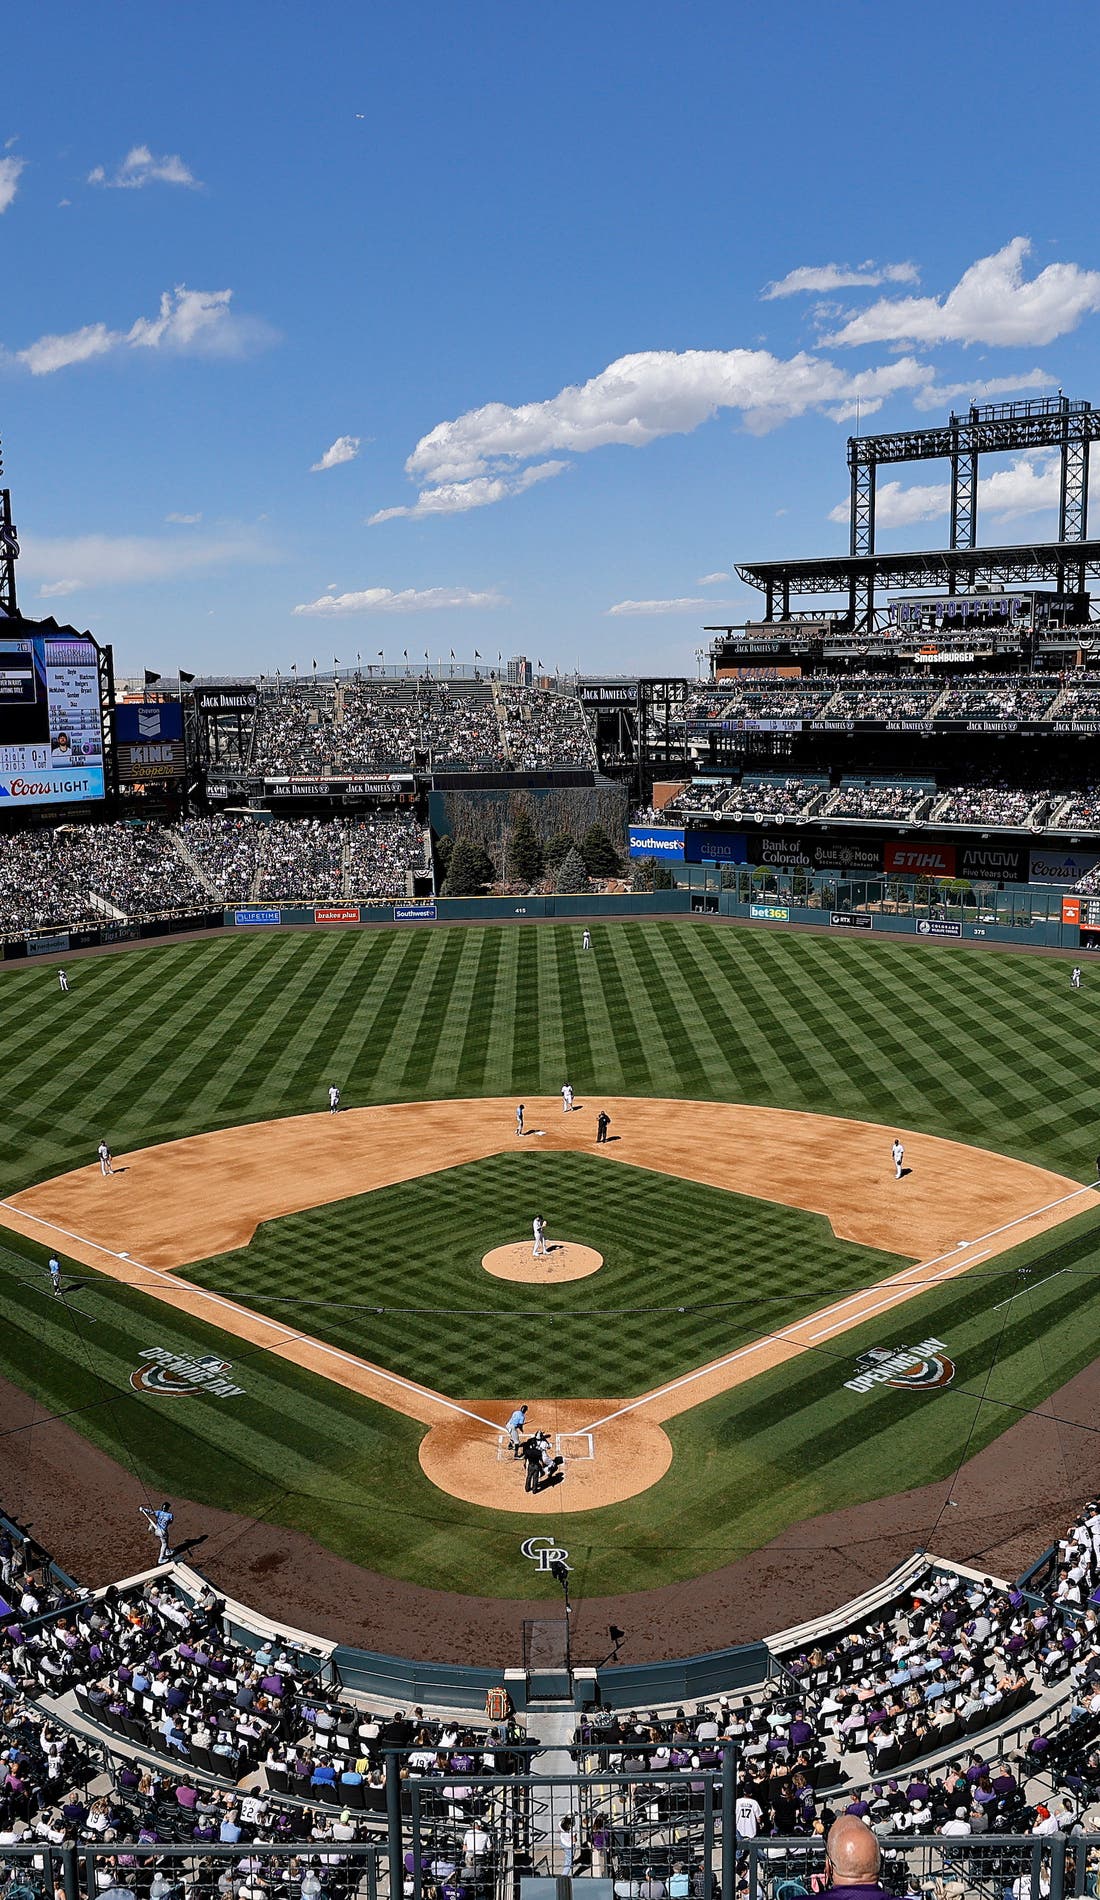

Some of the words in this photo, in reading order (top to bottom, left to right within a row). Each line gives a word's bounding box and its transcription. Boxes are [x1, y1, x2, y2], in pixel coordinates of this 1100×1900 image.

[890, 602, 922, 620] THE
[936, 598, 1022, 618] ROOFTOP
[734, 644, 748, 653] JACK
[581, 688, 599, 700] JACK
[600, 687, 627, 700] DANIEL'S
[200, 694, 219, 707] JACK
[220, 694, 248, 706] DANIEL'S
[810, 721, 824, 729] JACK
[824, 721, 846, 729] DANIEL'S
[886, 721, 900, 730] JACK
[902, 721, 924, 730] DANIEL'S
[967, 721, 982, 730] JACK
[984, 721, 1007, 731] DANIEL'S
[1053, 722, 1069, 731] JACK
[1072, 722, 1096, 732] DANIEL'S
[130, 745, 173, 763] KING
[131, 763, 174, 778] Soopers
[10, 779, 51, 796] Coors
[53, 780, 88, 793] LIGHT
[273, 785, 290, 794] JACK
[292, 784, 319, 794] DANIEL'S
[346, 784, 363, 793] JACK
[365, 783, 391, 792] DANIEL'S
[630, 837, 678, 850] Southwest
[701, 843, 731, 856] cigna
[762, 839, 786, 852] Bank
[789, 840, 800, 852] of
[762, 852, 810, 865] Colorado
[815, 848, 837, 860] BLUE
[854, 853, 879, 862] MOON
[893, 852, 946, 868] STIHL
[980, 869, 1000, 878] Years
[1002, 870, 1018, 879] Out
[1031, 861, 1072, 876] Coors
[751, 906, 787, 919] bet365
[843, 1352, 921, 1393] OPENING
[908, 1337, 948, 1358] DAY
[138, 1347, 215, 1383] OPENING
[200, 1379, 247, 1398] DAY
[521, 1537, 574, 1571] CR
[91, 1814, 100, 1823] 19
[241, 1806, 254, 1818] 22
[741, 1808, 751, 1818] 17
